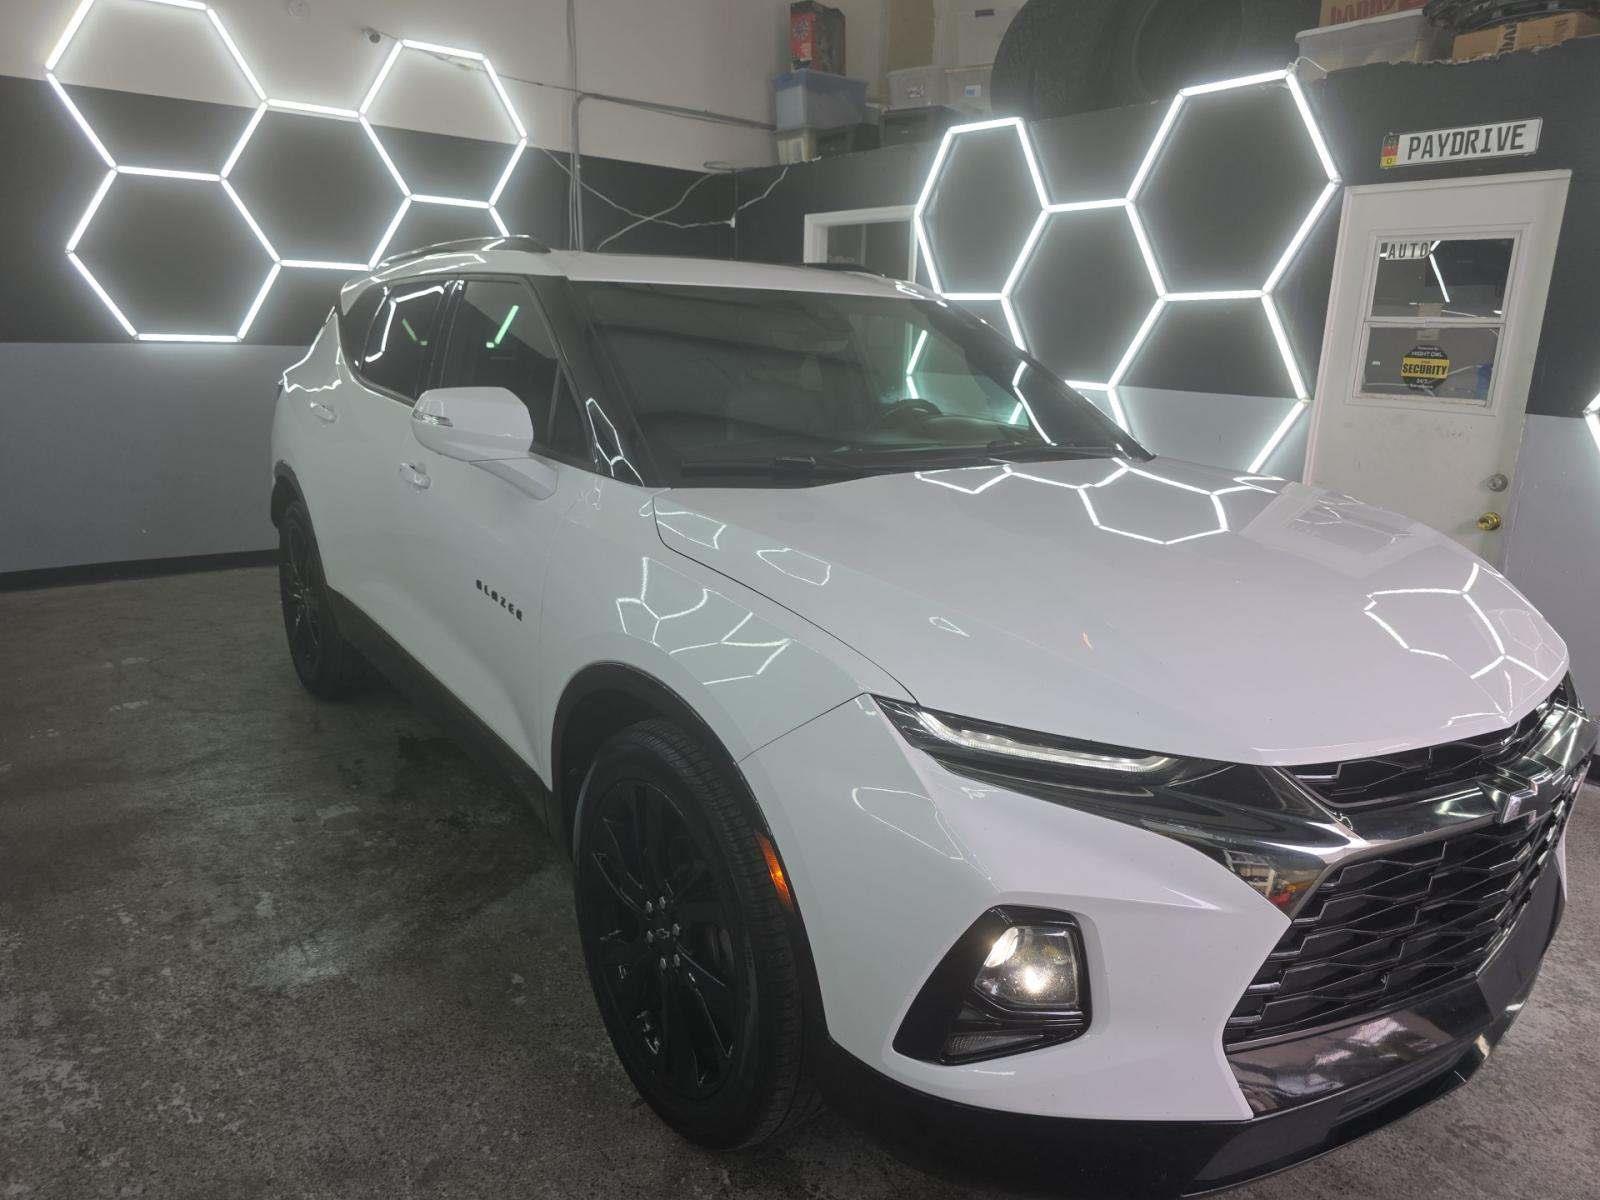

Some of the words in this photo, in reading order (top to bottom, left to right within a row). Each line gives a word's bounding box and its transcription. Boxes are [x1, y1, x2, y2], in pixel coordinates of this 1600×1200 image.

[1407, 124, 1526, 160] PAYDRIVE
[1388, 242, 1429, 259] AUTO
[1402, 363, 1447, 376] SECURITY
[476, 579, 522, 622] BLAZER
